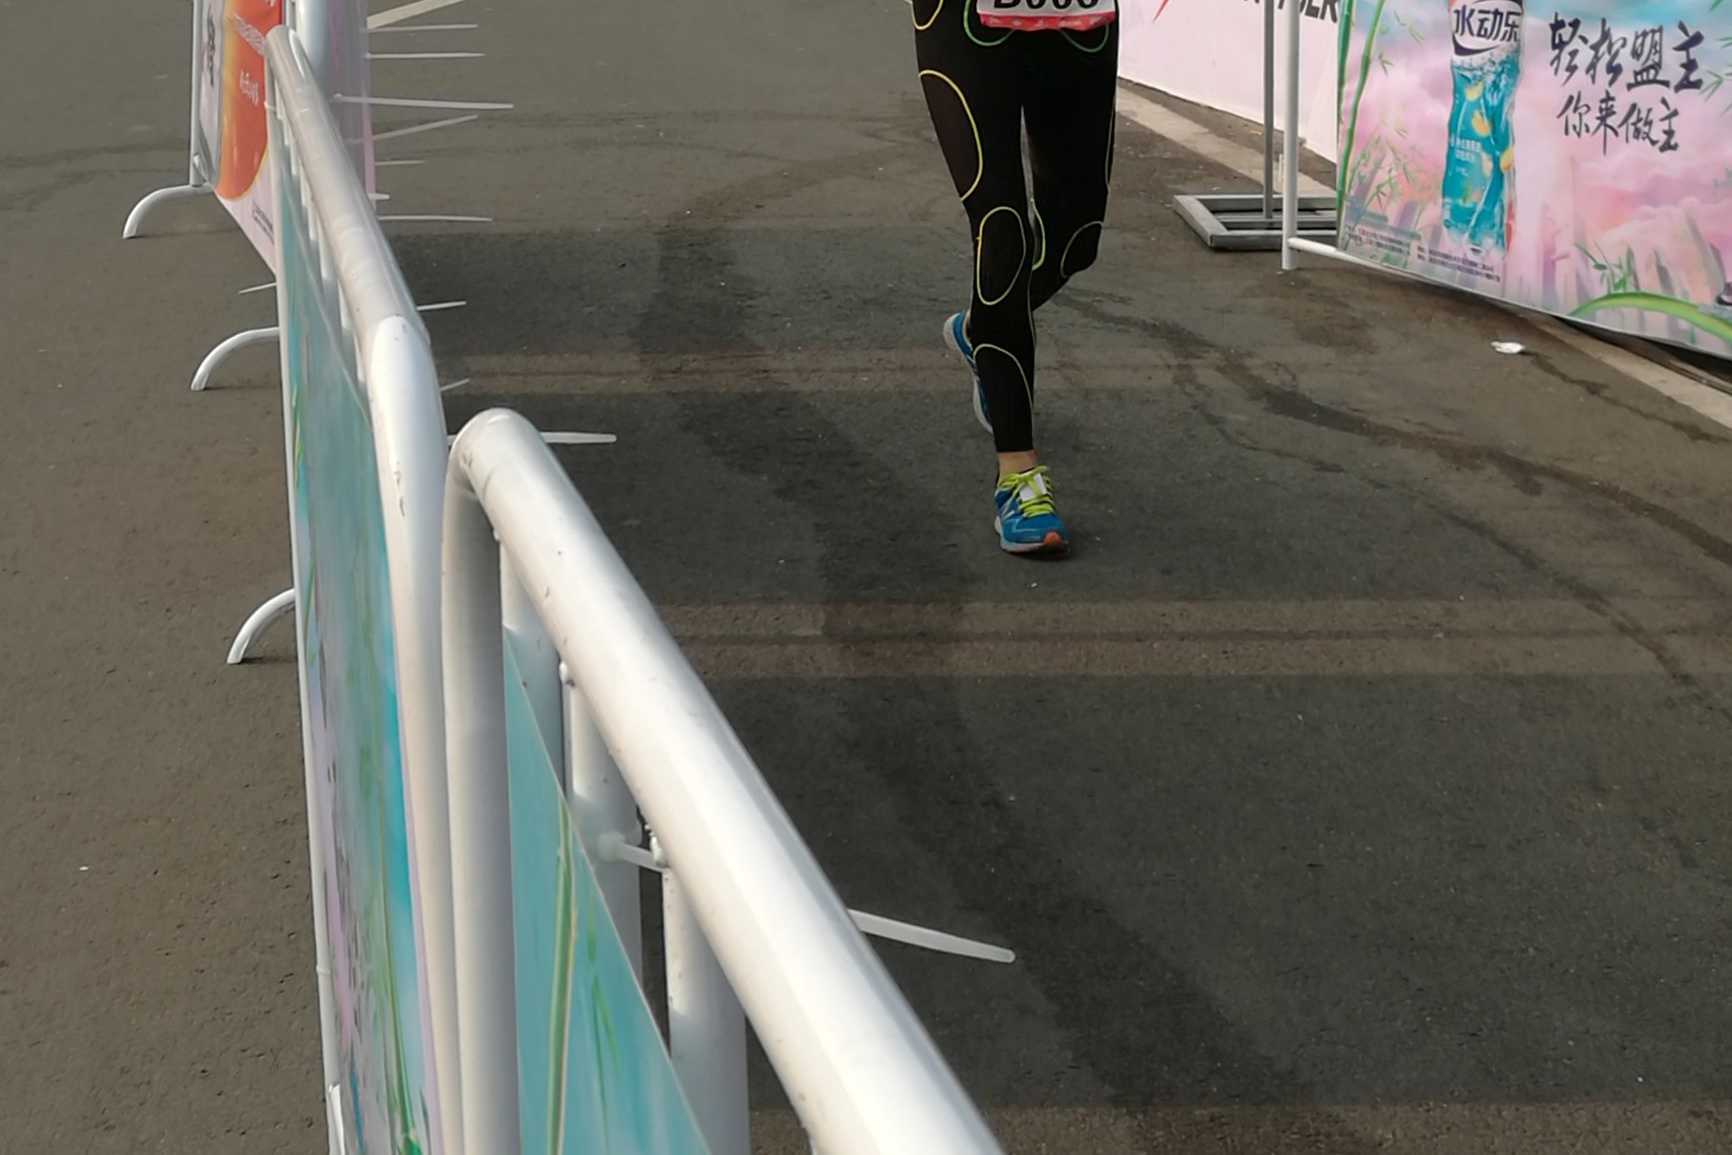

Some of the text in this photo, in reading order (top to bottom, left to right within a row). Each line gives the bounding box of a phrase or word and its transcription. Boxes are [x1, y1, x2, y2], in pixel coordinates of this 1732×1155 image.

[1454, 4, 1522, 43] 水动乐
[1549, 11, 1705, 94] 轻松盟主
[1557, 89, 1680, 156] 你来做主
